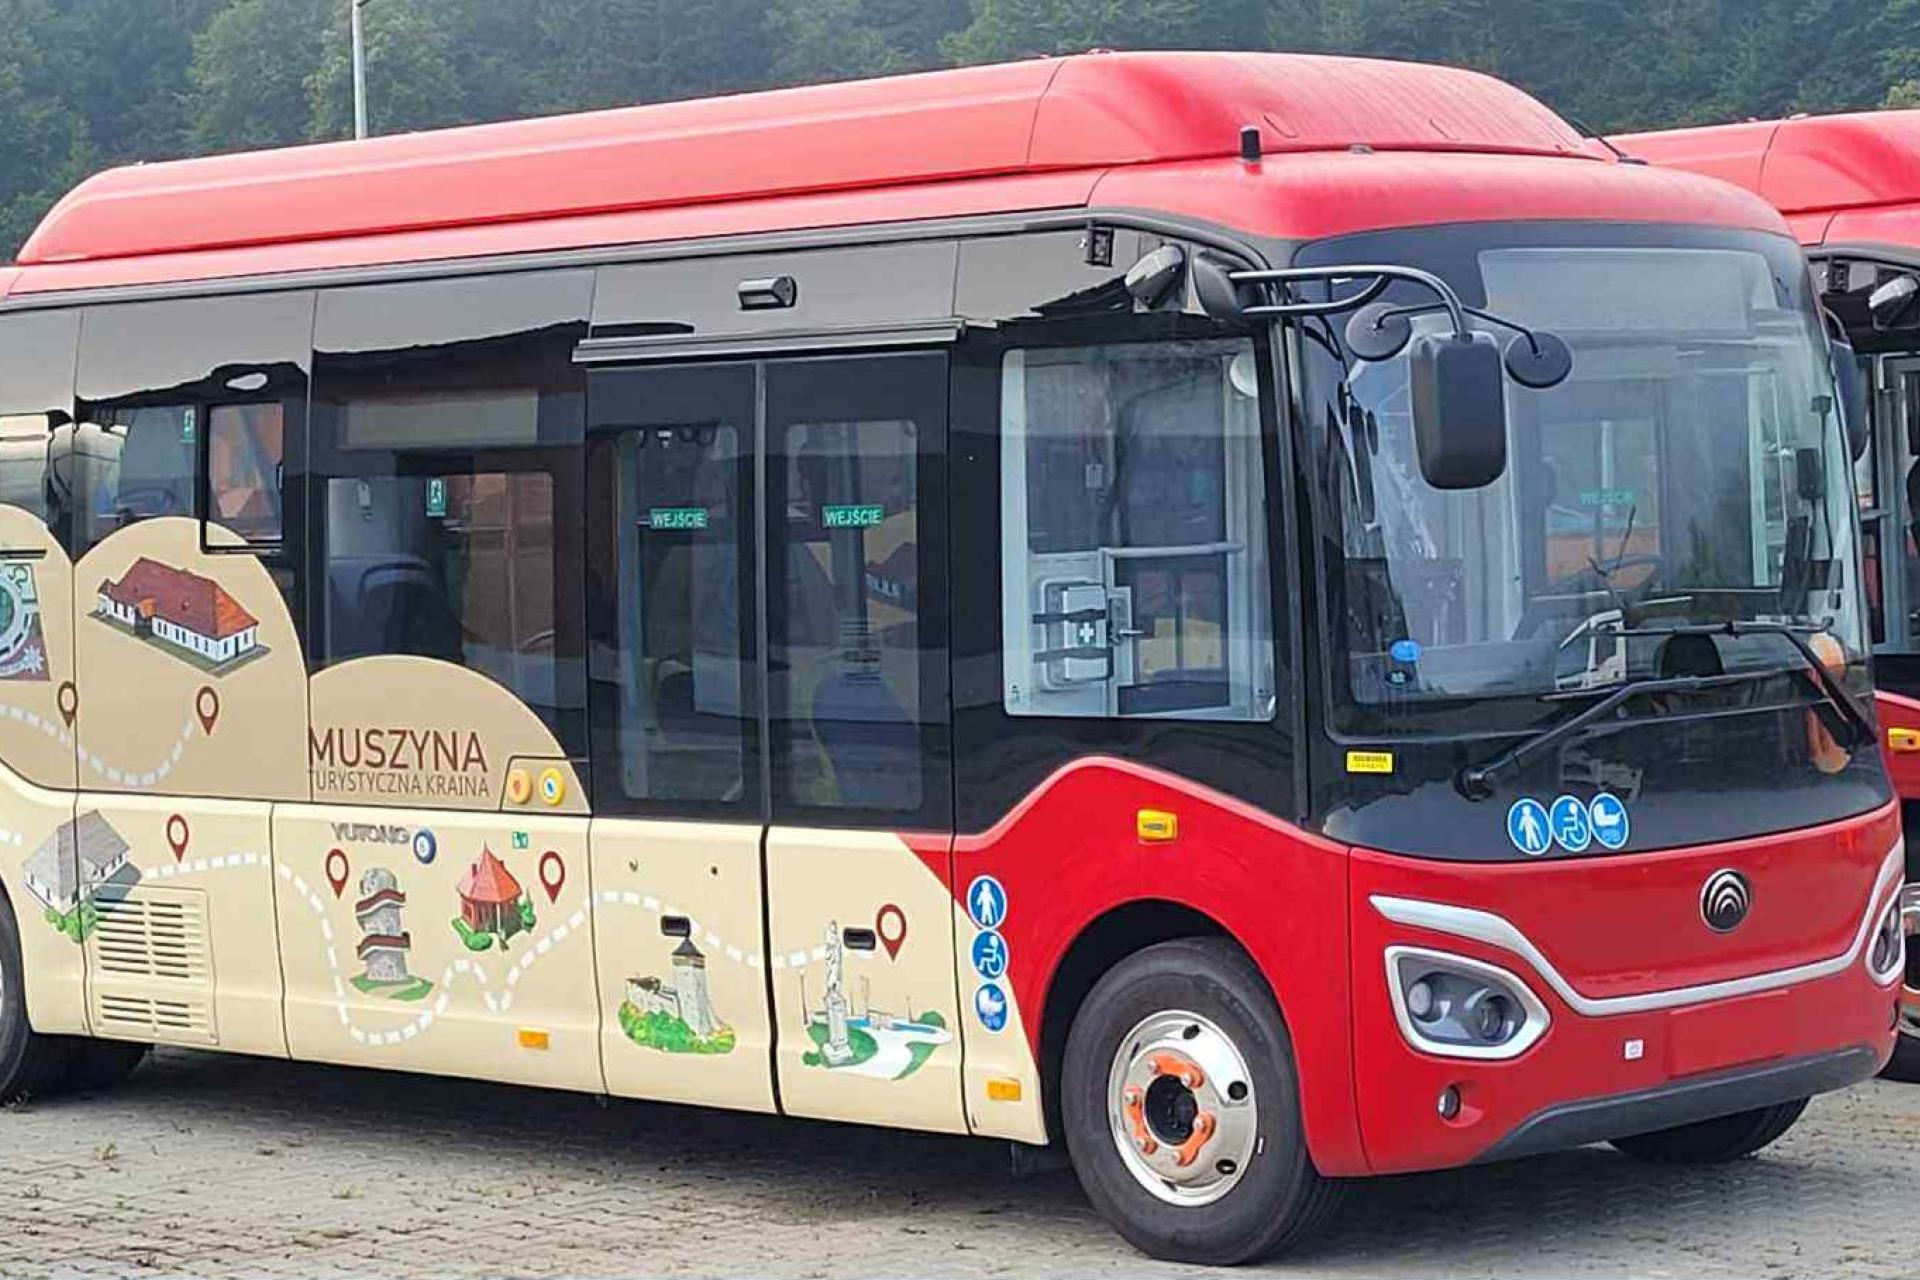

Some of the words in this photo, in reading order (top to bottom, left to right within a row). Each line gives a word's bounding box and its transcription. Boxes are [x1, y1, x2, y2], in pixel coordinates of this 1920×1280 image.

[825, 506, 881, 525] WEJŚCIE
[308, 727, 488, 772] MUSZYNA
[426, 777, 490, 797] KRAINA
[331, 822, 411, 844] YUTONG
